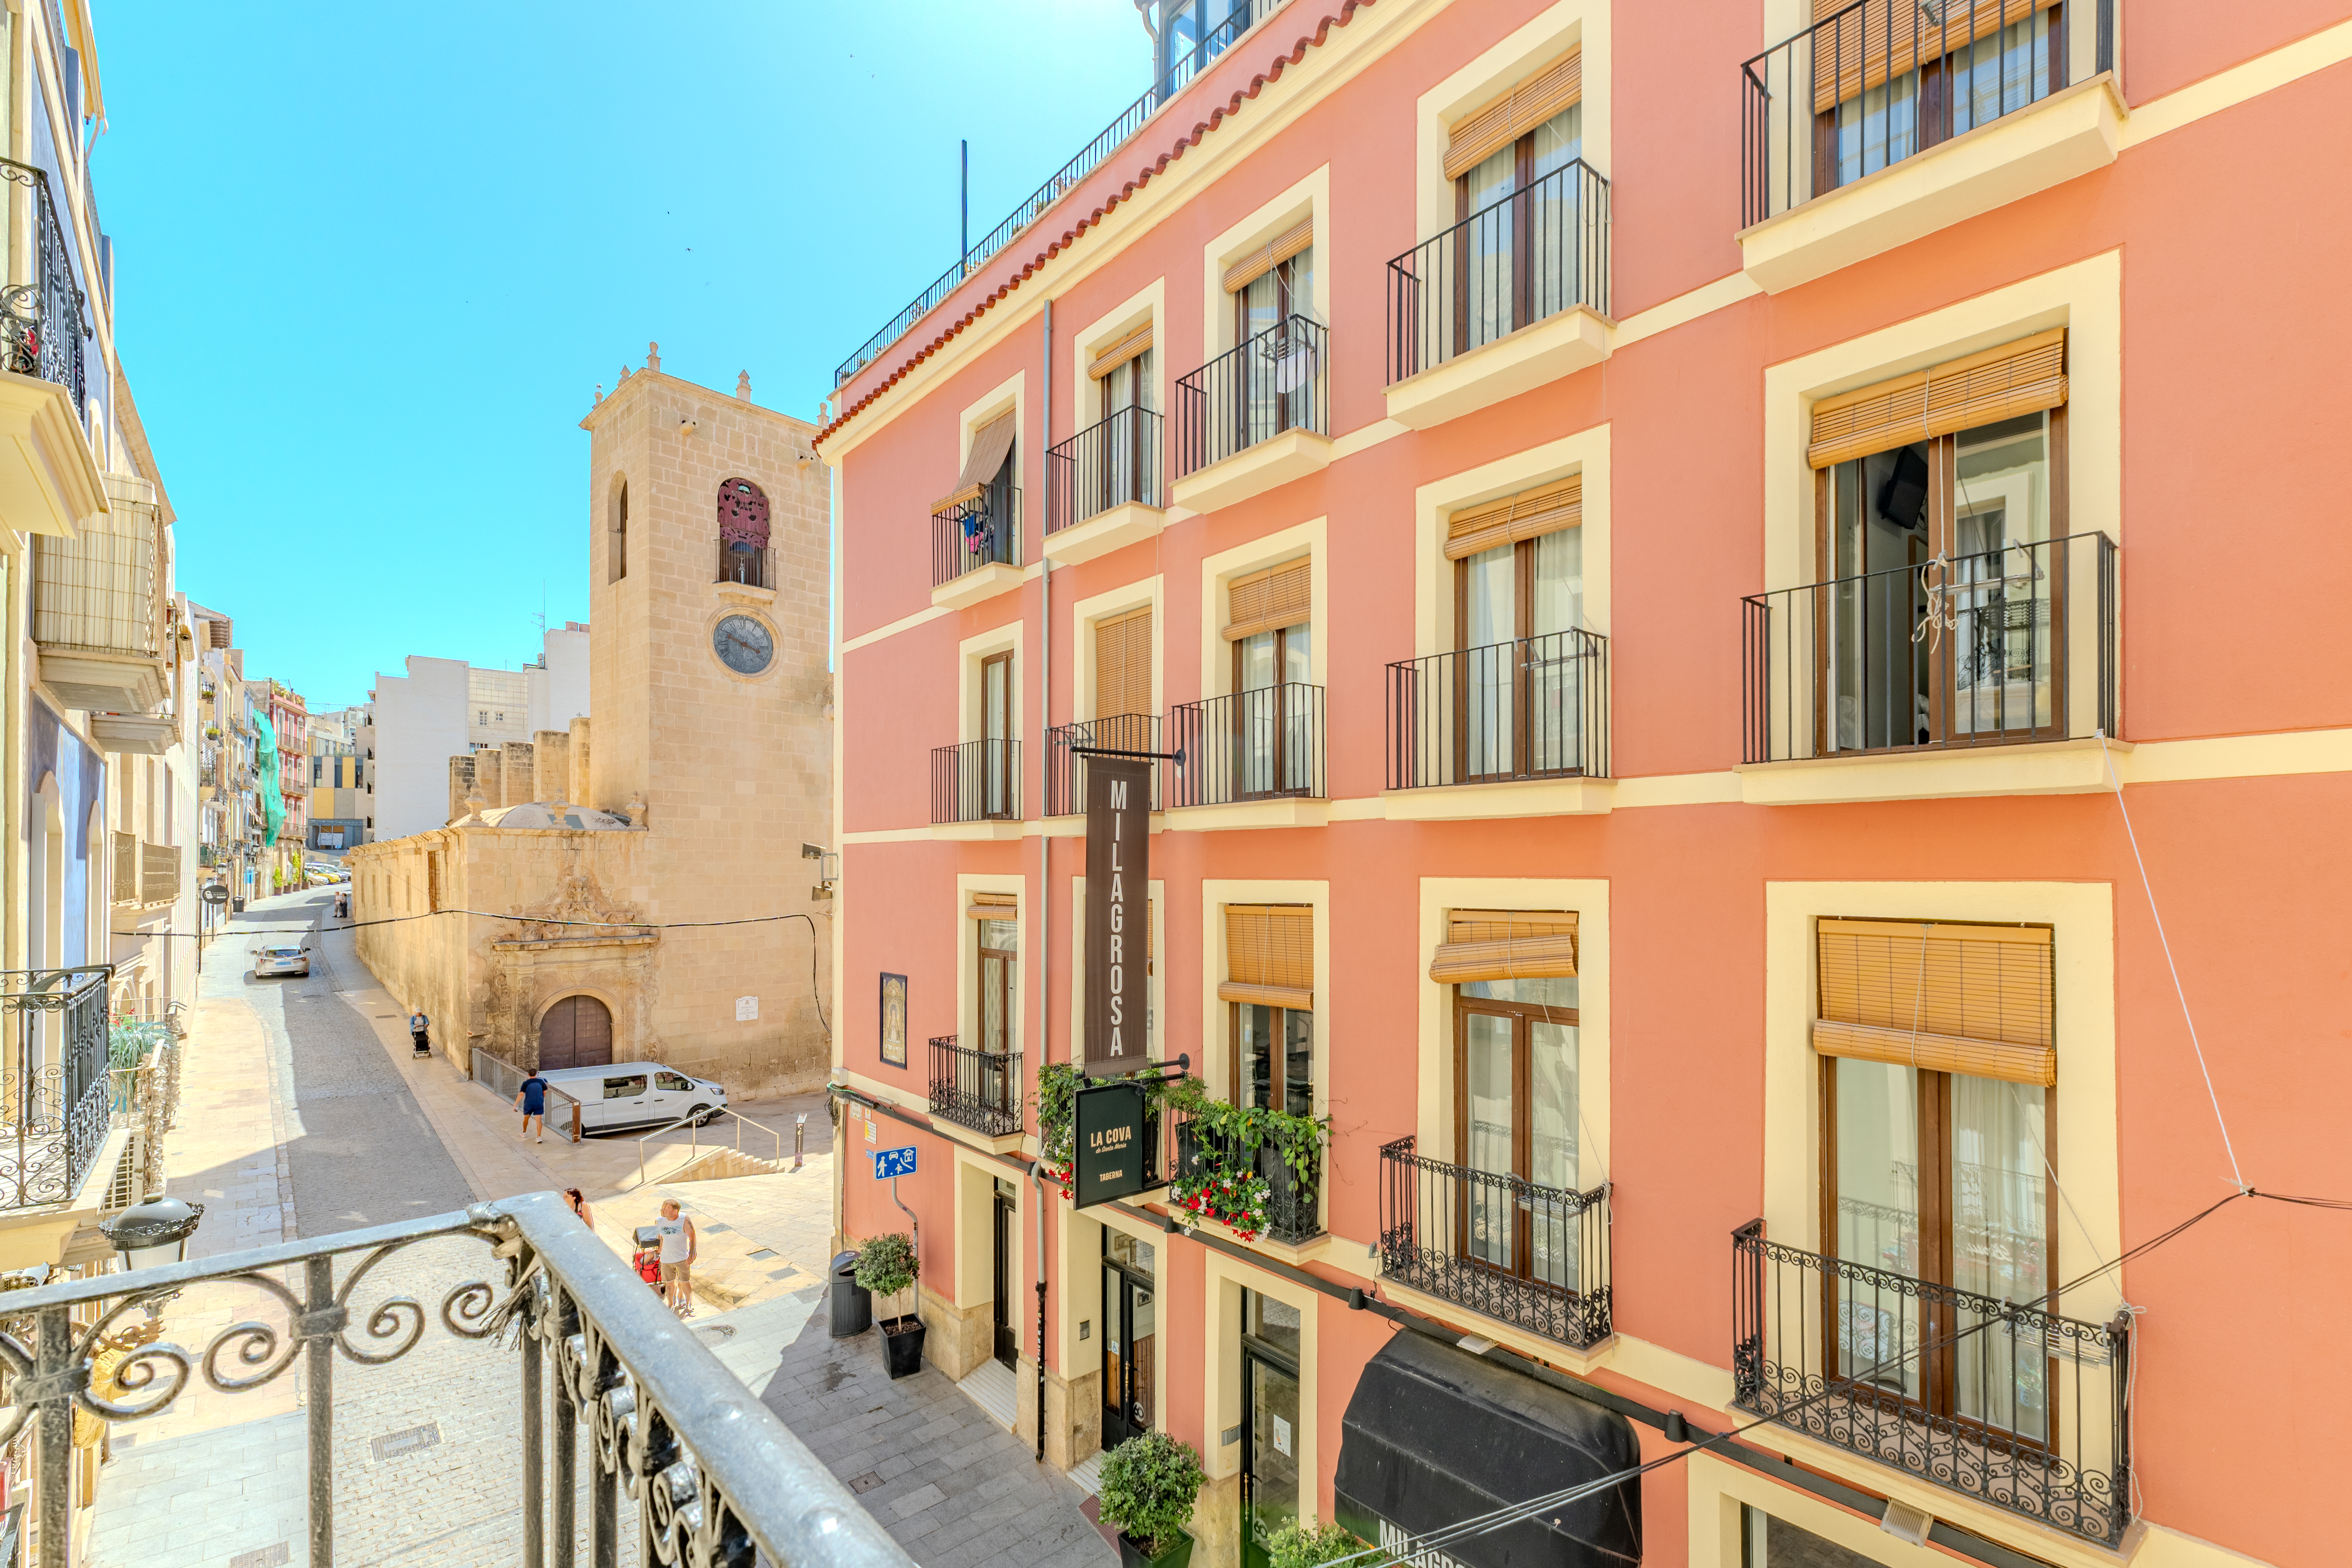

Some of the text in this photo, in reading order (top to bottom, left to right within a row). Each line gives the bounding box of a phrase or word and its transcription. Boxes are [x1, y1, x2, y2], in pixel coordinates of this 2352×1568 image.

[1110, 780, 1127, 1057] MILAGROSA
[1091, 1126, 1132, 1147] LA COVA
[1099, 1169, 1123, 1182] TABERNA
